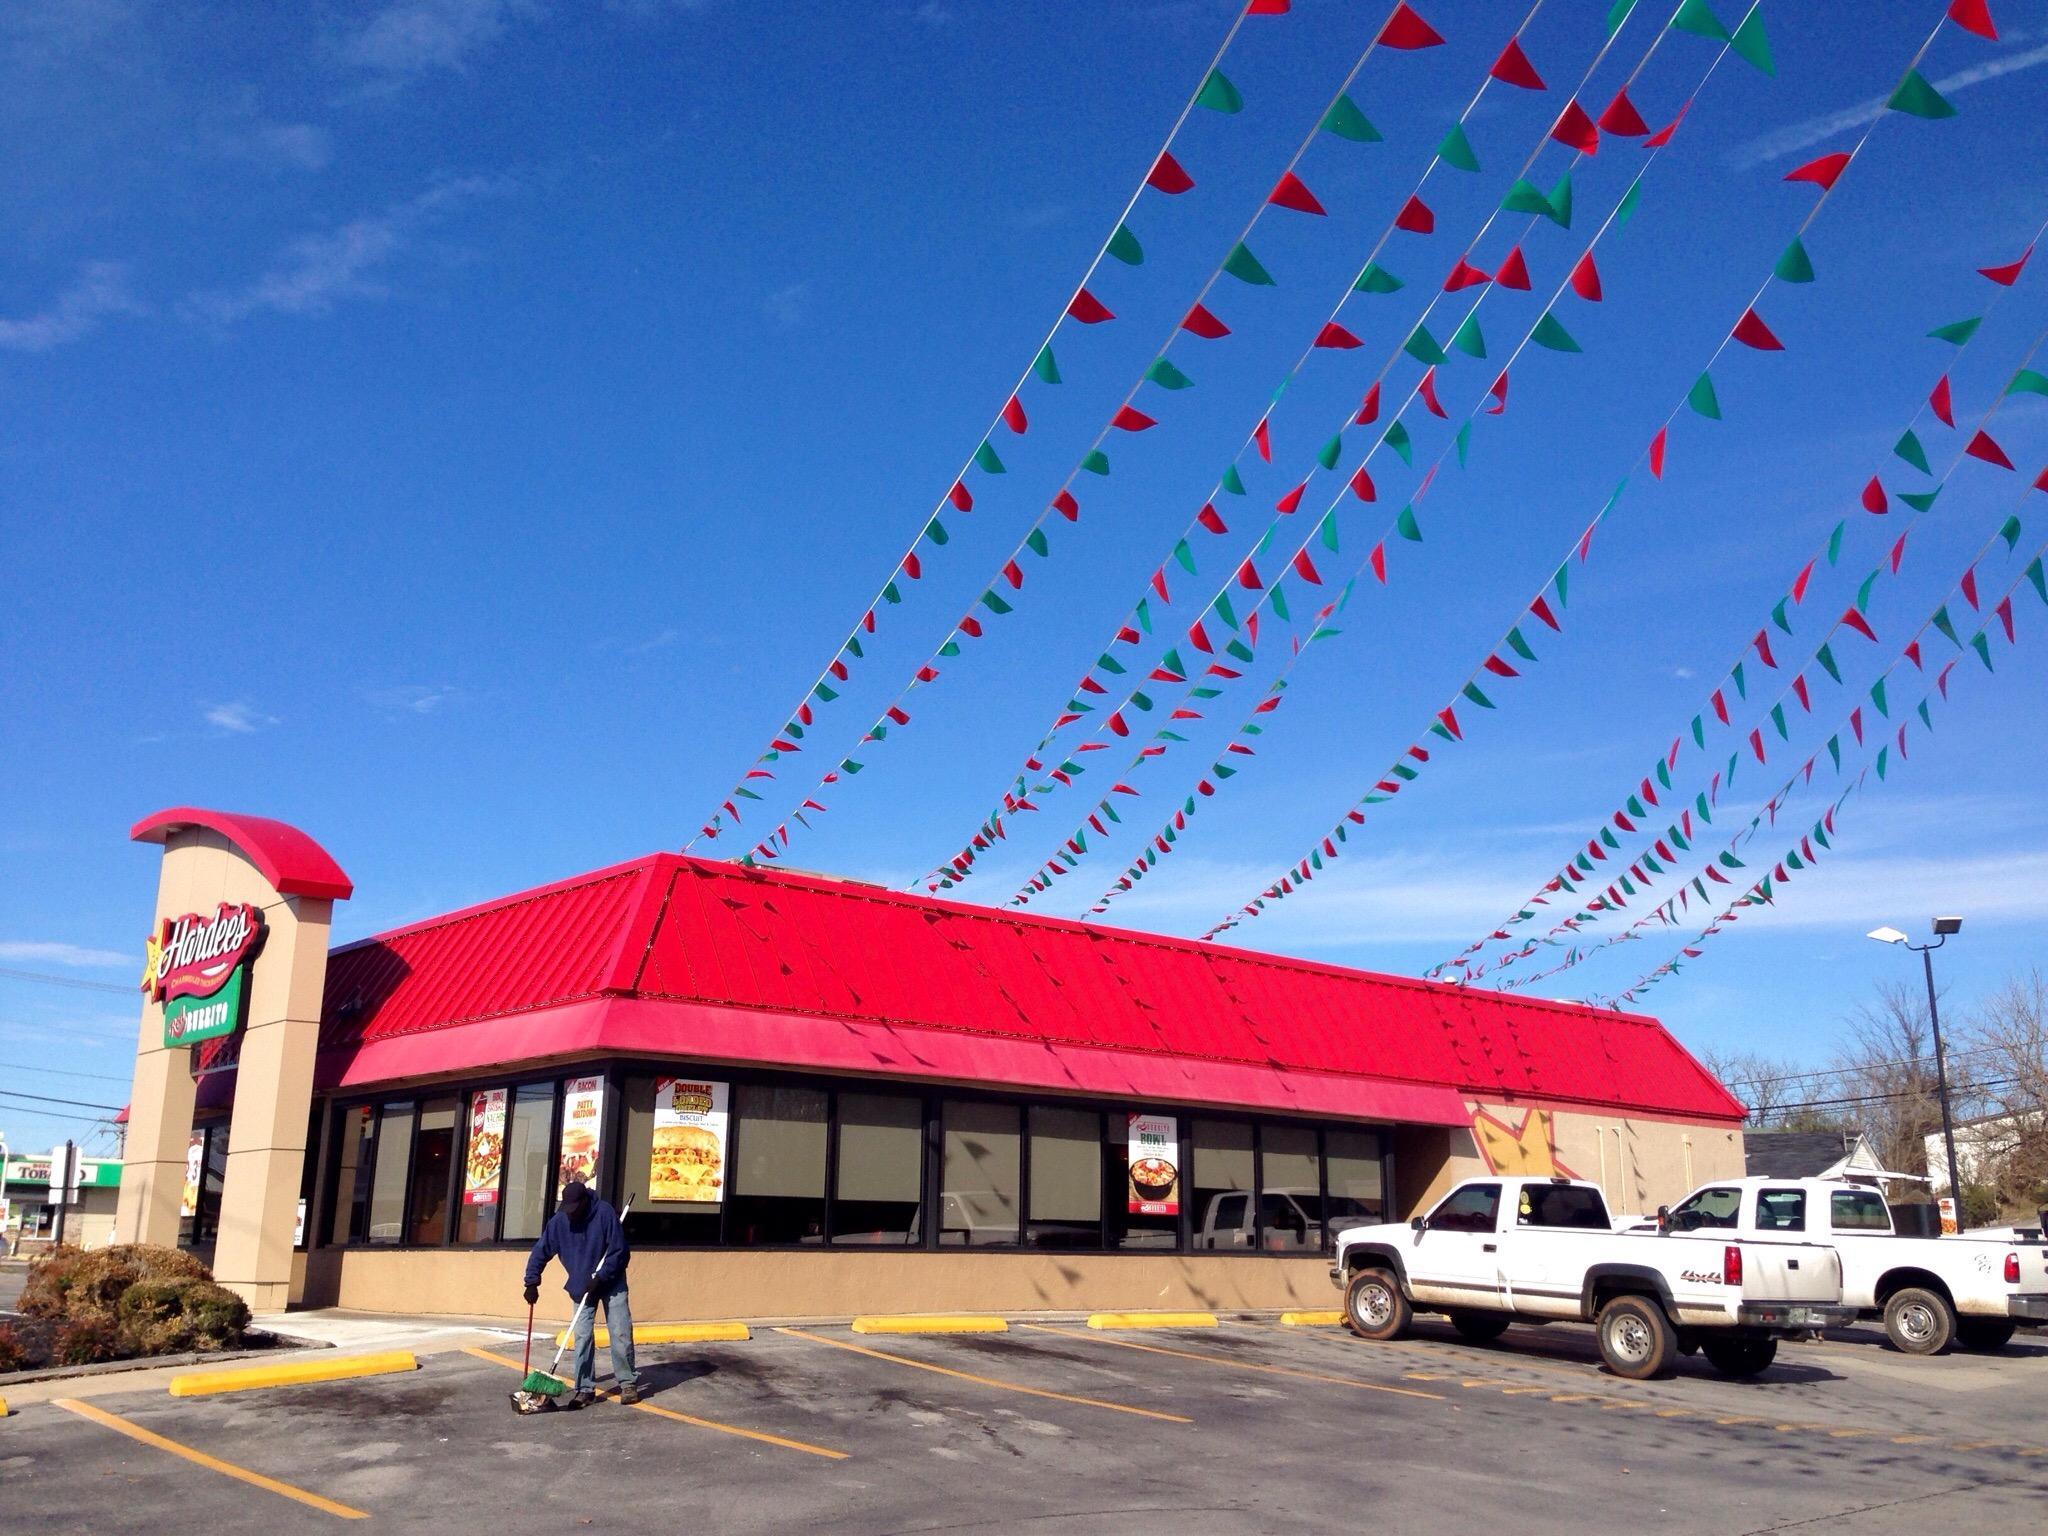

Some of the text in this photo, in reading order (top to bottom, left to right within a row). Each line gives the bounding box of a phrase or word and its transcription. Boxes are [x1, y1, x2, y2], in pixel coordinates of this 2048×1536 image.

[157, 904, 251, 979] Hardee's
[186, 1001, 228, 1033] BURRITO
[577, 1080, 597, 1092] BACON
[675, 1083, 712, 1095] DOUBLE
[576, 1100, 593, 1109] PATTY
[1140, 1133, 1167, 1146] BOWL
[18, 1166, 86, 1181] TOBO
[1680, 1270, 1722, 1284] 4x4
